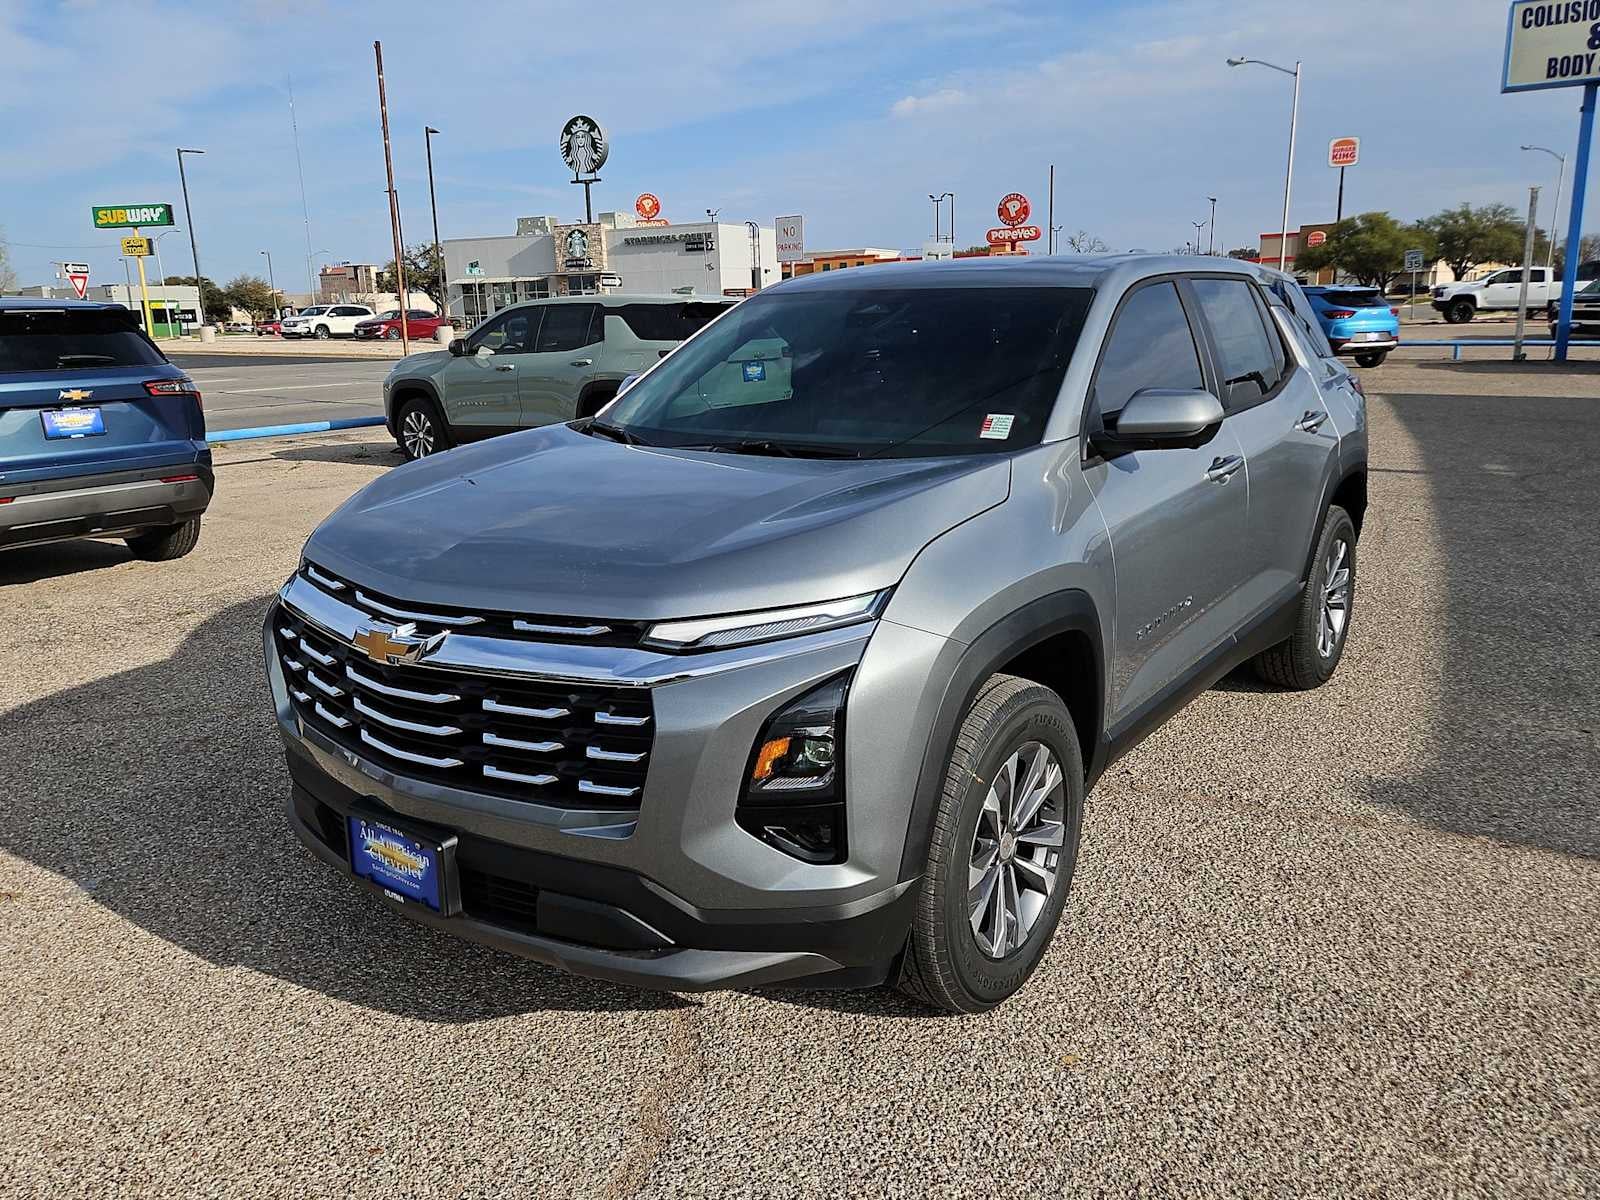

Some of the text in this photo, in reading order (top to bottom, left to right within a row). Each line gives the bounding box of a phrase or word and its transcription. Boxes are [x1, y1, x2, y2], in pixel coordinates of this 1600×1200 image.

[1546, 53, 1596, 79] BODY
[1332, 151, 1356, 160] KING
[97, 206, 164, 224] SUBWAY
[784, 226, 795, 237] NO
[776, 242, 801, 251] PARKING
[360, 827, 375, 841] All
[369, 846, 422, 880] Chevrolet
